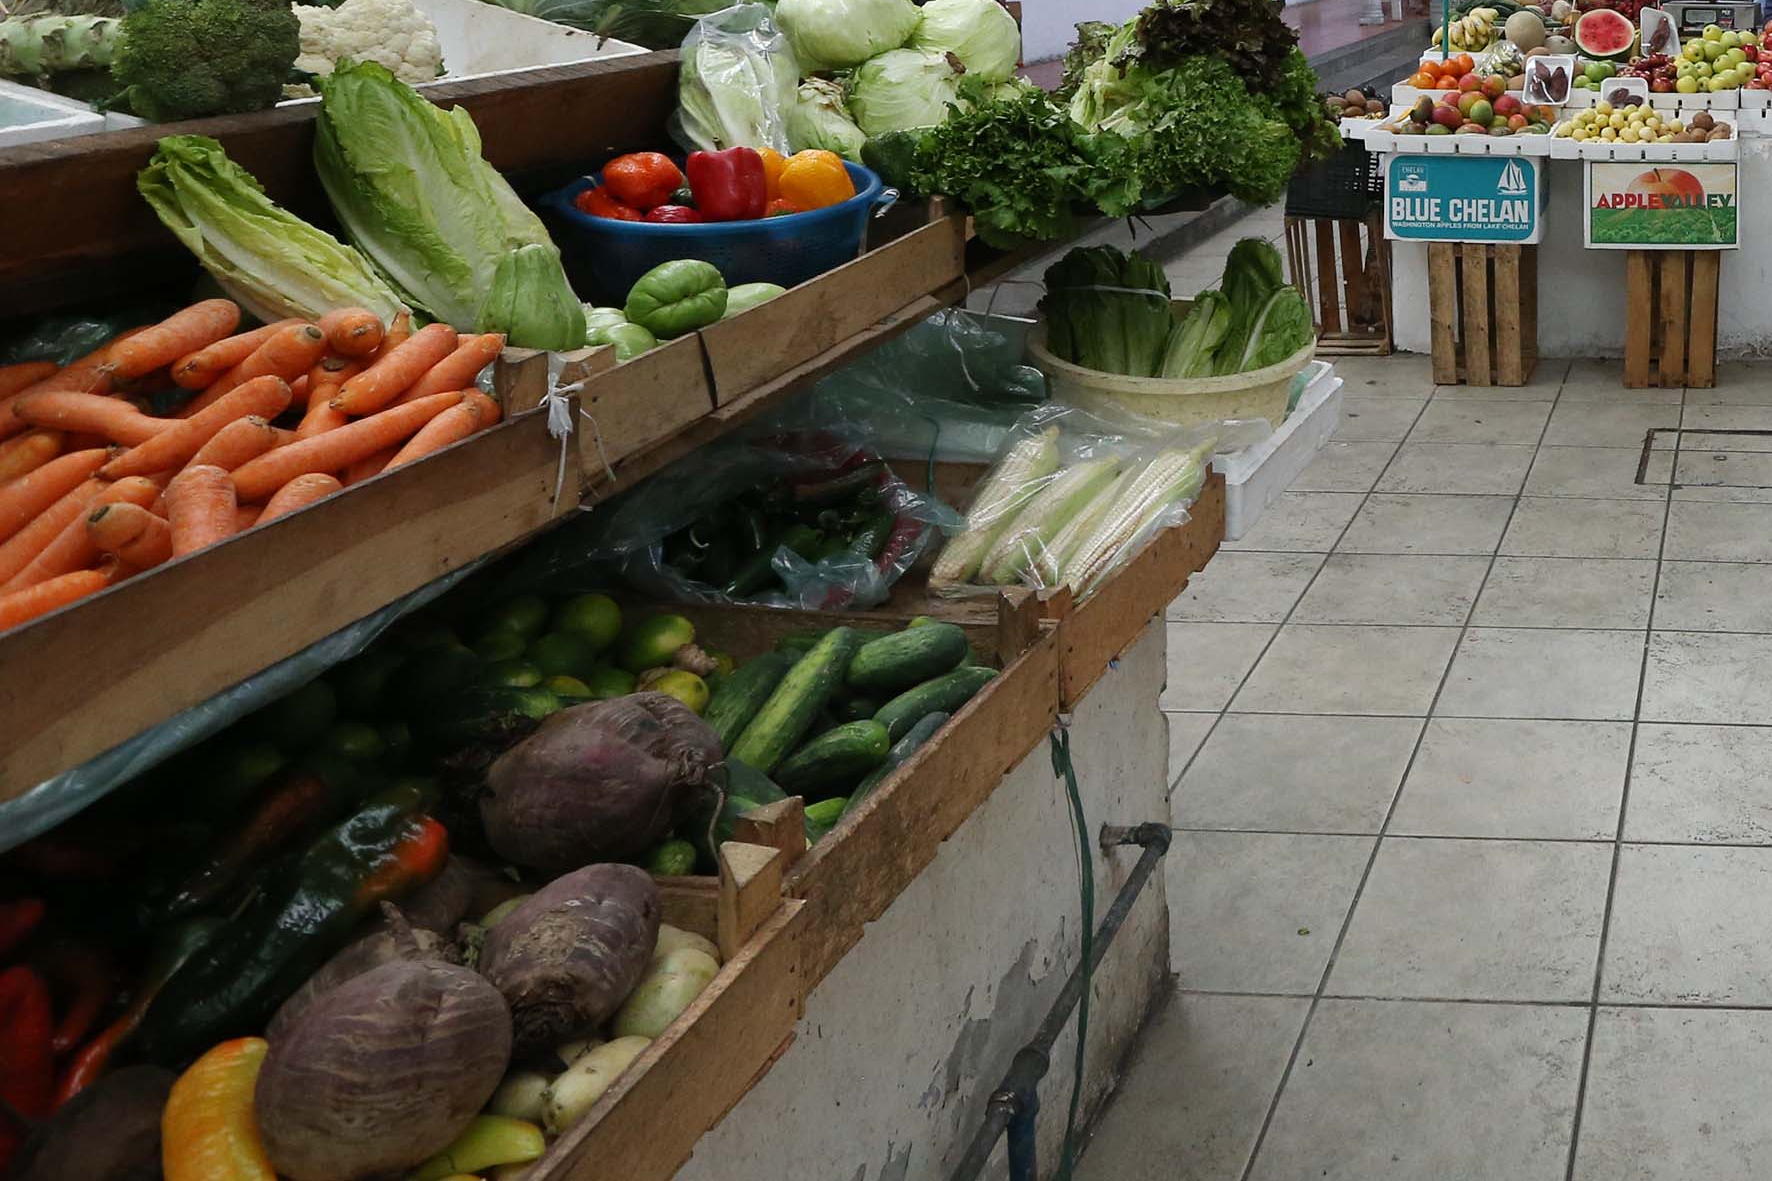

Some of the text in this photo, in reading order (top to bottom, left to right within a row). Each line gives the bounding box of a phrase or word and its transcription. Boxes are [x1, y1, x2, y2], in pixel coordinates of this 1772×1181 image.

[1391, 197, 1529, 223] BLUE CHELAN
[1391, 221, 1435, 229] WASHINGTON
